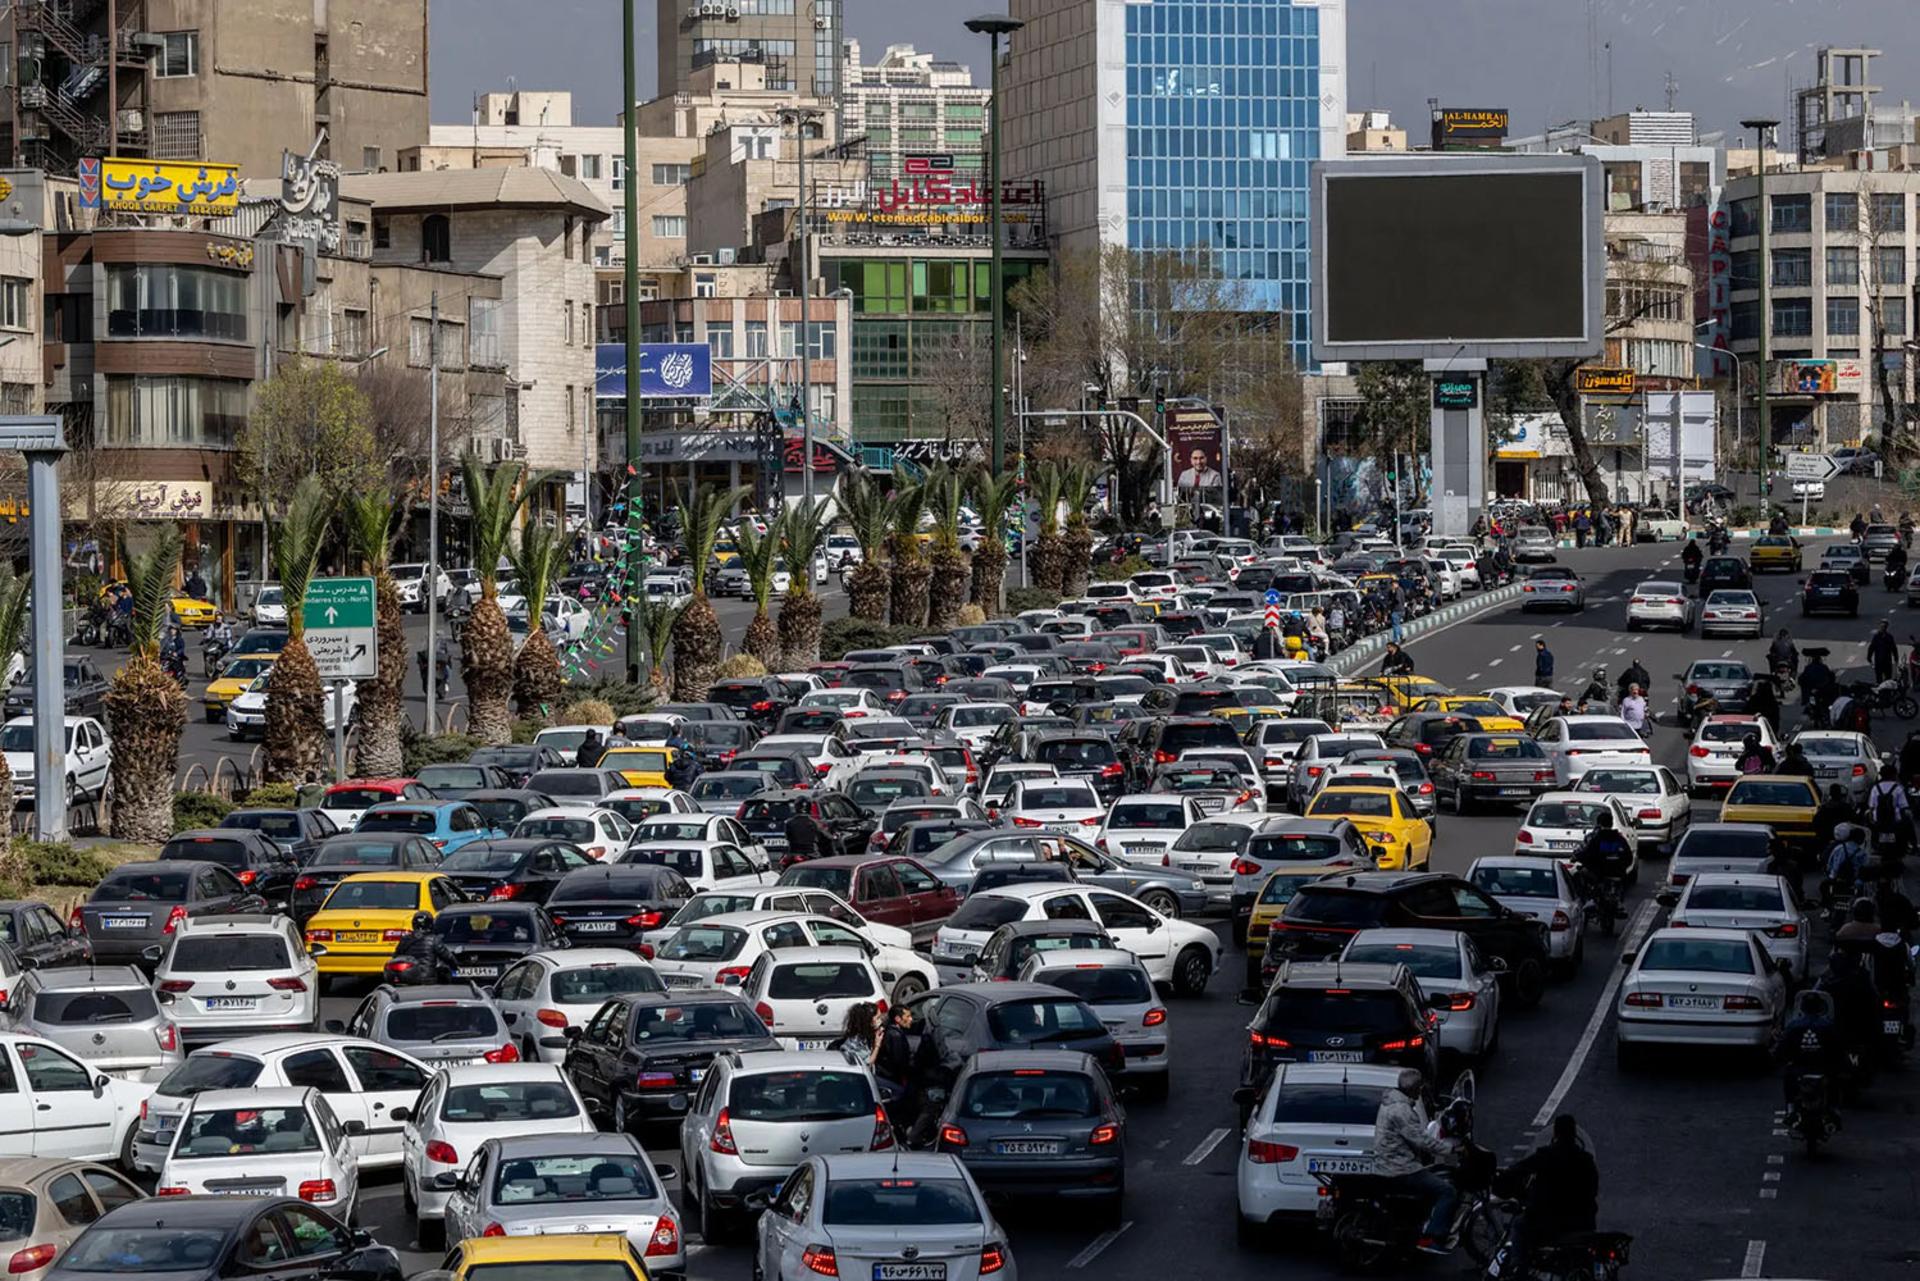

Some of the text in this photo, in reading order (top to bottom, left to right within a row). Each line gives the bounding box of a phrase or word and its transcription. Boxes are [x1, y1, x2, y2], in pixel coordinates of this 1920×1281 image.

[1448, 112, 1500, 120] AL-HAMRA
[106, 166, 238, 202] فرش خوب
[823, 177, 1040, 213] اعتماد کابل البرز
[109, 201, 141, 211] KHOOB
[144, 203, 179, 213] CARPET
[1711, 210, 1728, 377] CAPITAL
[914, 440, 938, 460] فاخر
[170, 488, 201, 511] فرش
[306, 636, 342, 644] سهروردی
[313, 646, 342, 656] شریعتی
